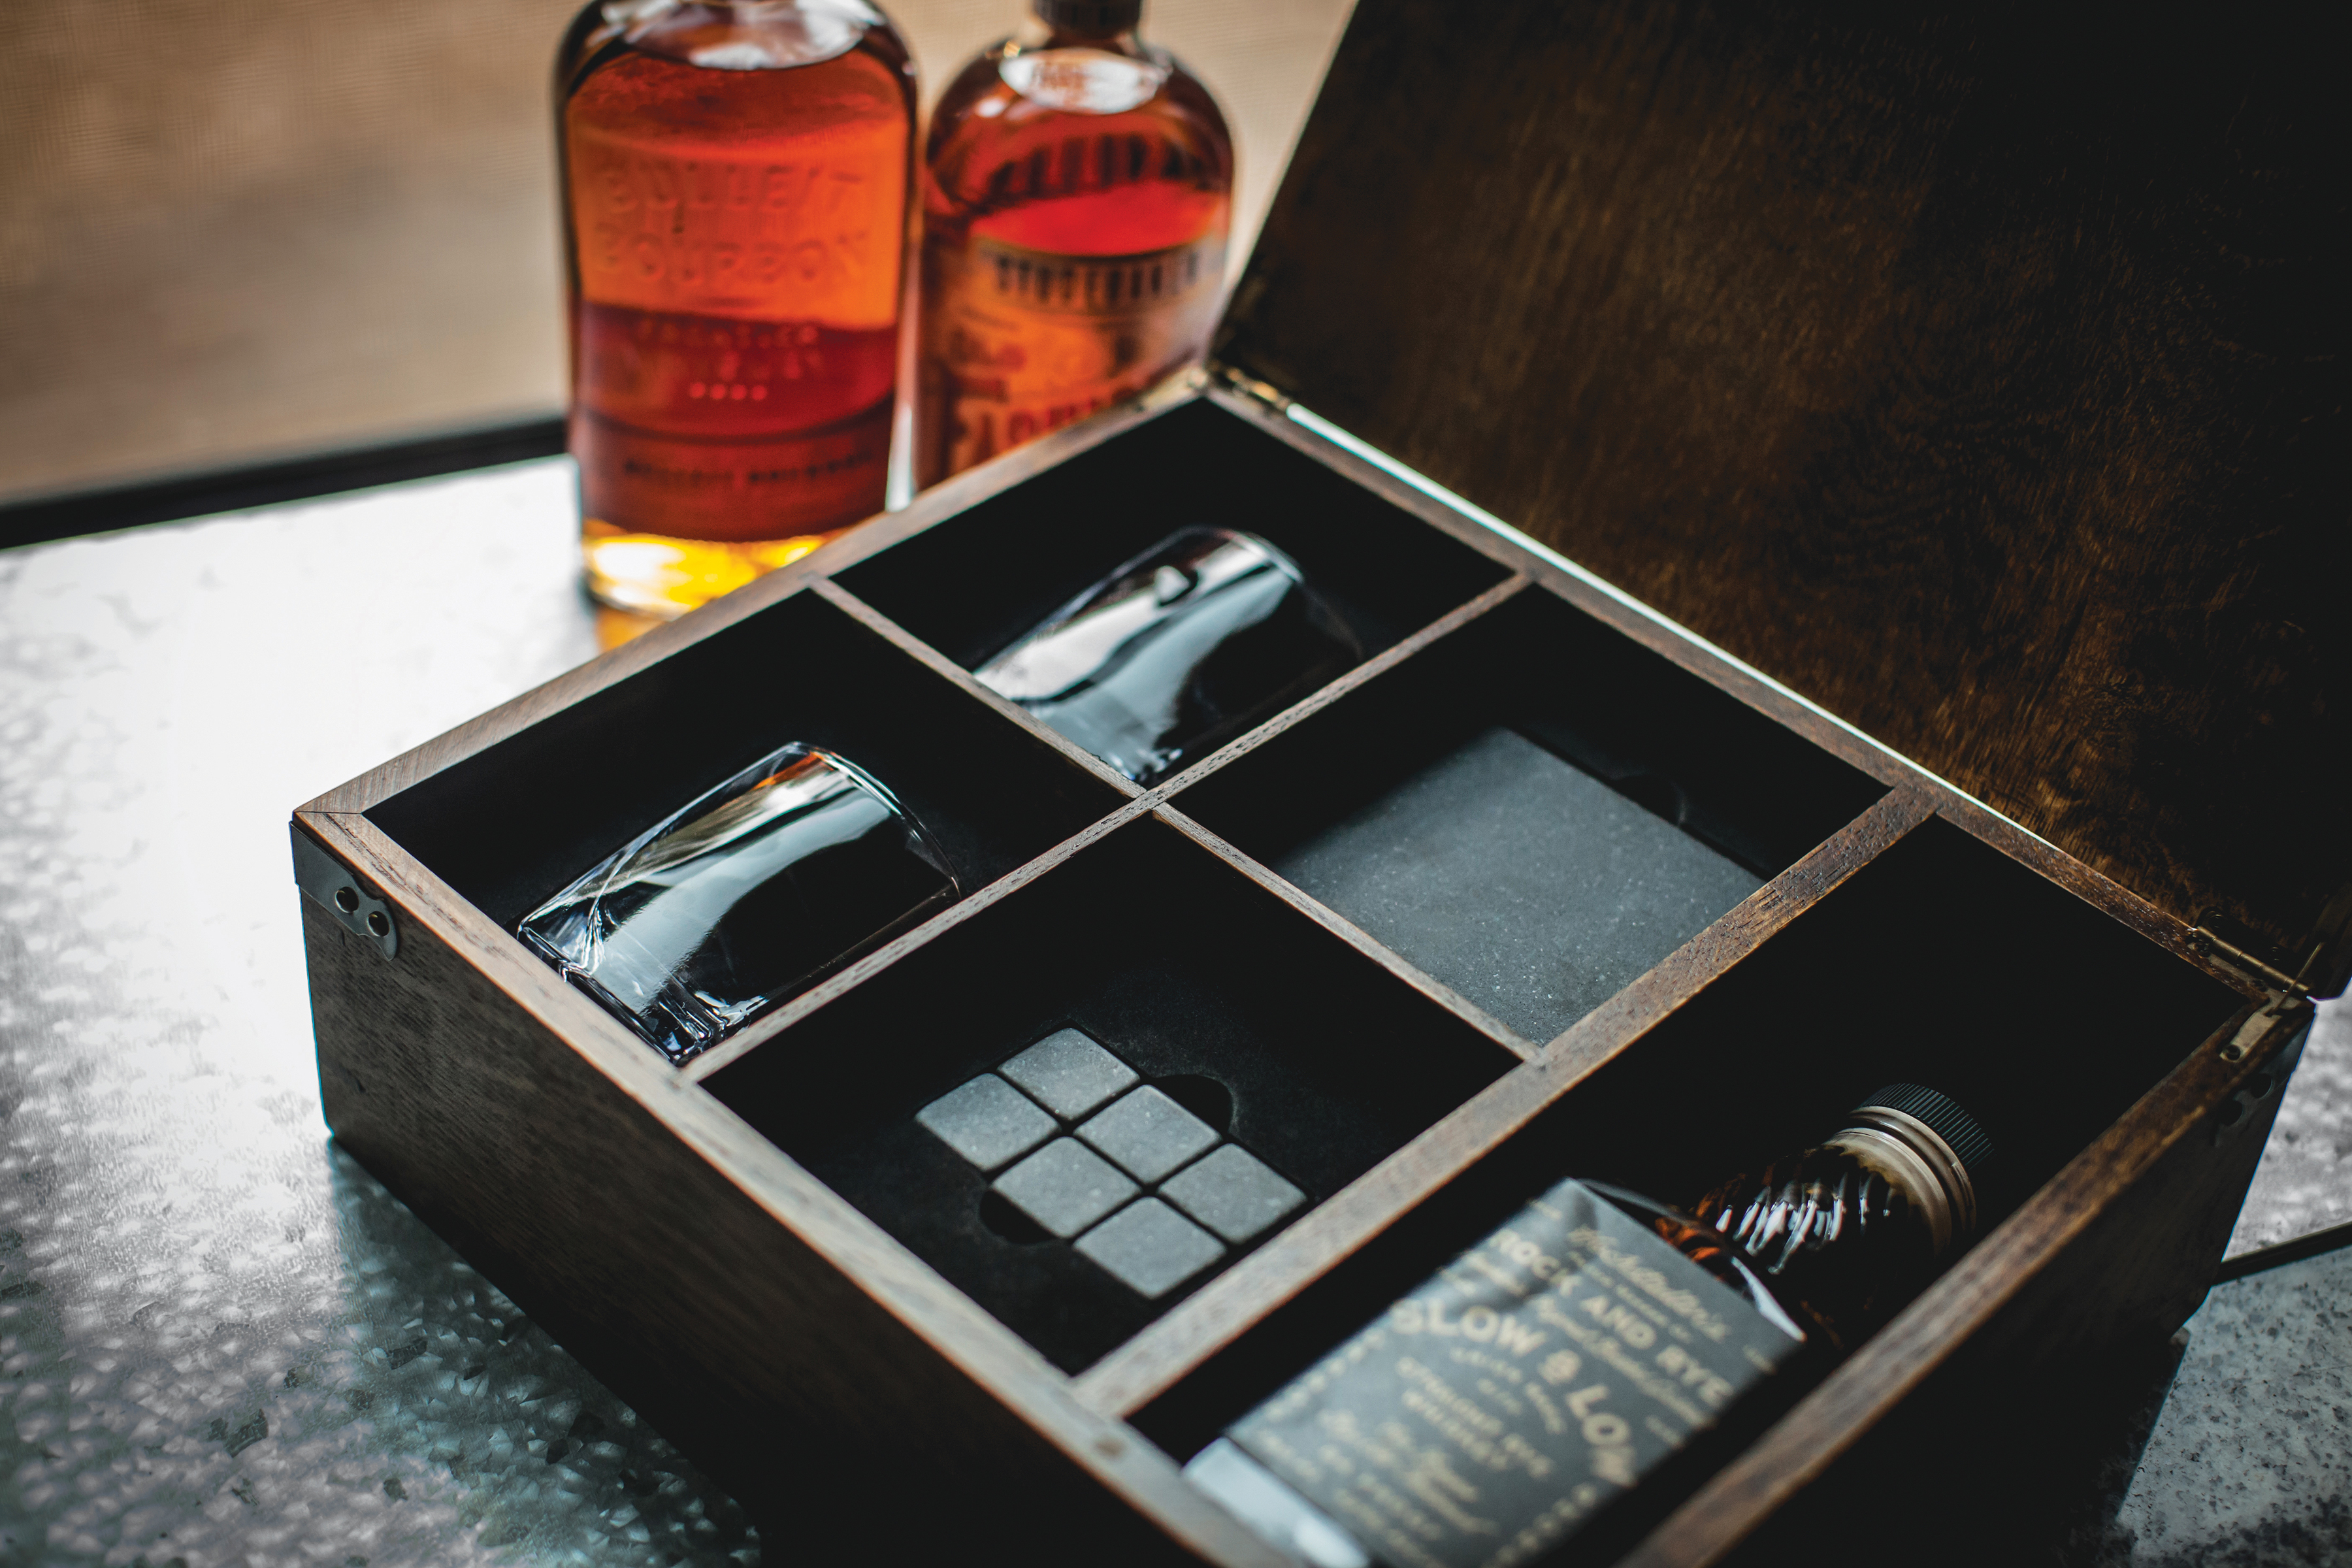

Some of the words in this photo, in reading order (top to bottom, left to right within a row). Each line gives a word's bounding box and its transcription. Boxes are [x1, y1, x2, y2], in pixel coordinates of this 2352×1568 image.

[1391, 1295, 1548, 1358] SLOW
[1566, 1383, 1637, 1490] LOW
[1488, 1227, 1582, 1296] ROCK
[1580, 1295, 1658, 1350] AND
[1654, 1343, 1734, 1407] RYE
